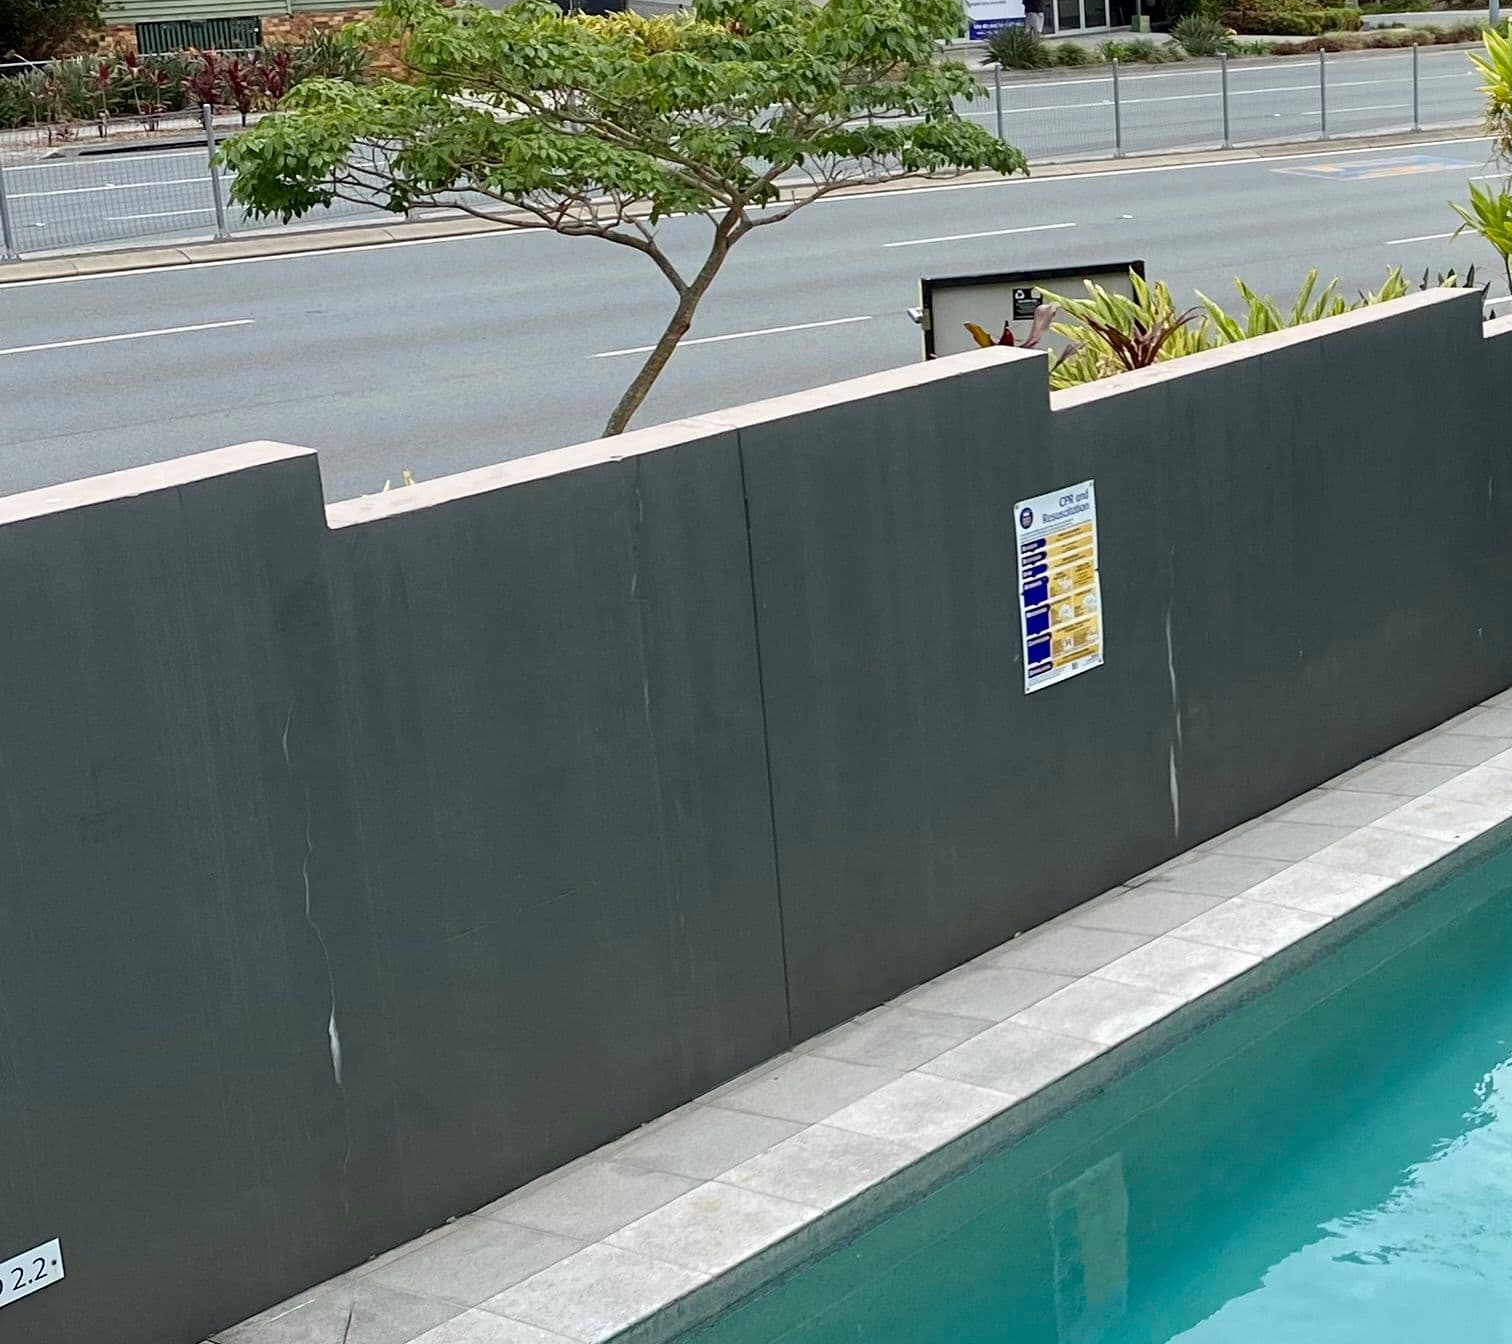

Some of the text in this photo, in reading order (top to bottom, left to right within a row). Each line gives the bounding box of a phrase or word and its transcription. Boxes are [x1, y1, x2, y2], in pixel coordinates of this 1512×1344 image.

[1059, 488, 1089, 507] CPR and
[1042, 502, 1090, 524] Resuscitation
[10, 1257, 48, 1291] 2.2
